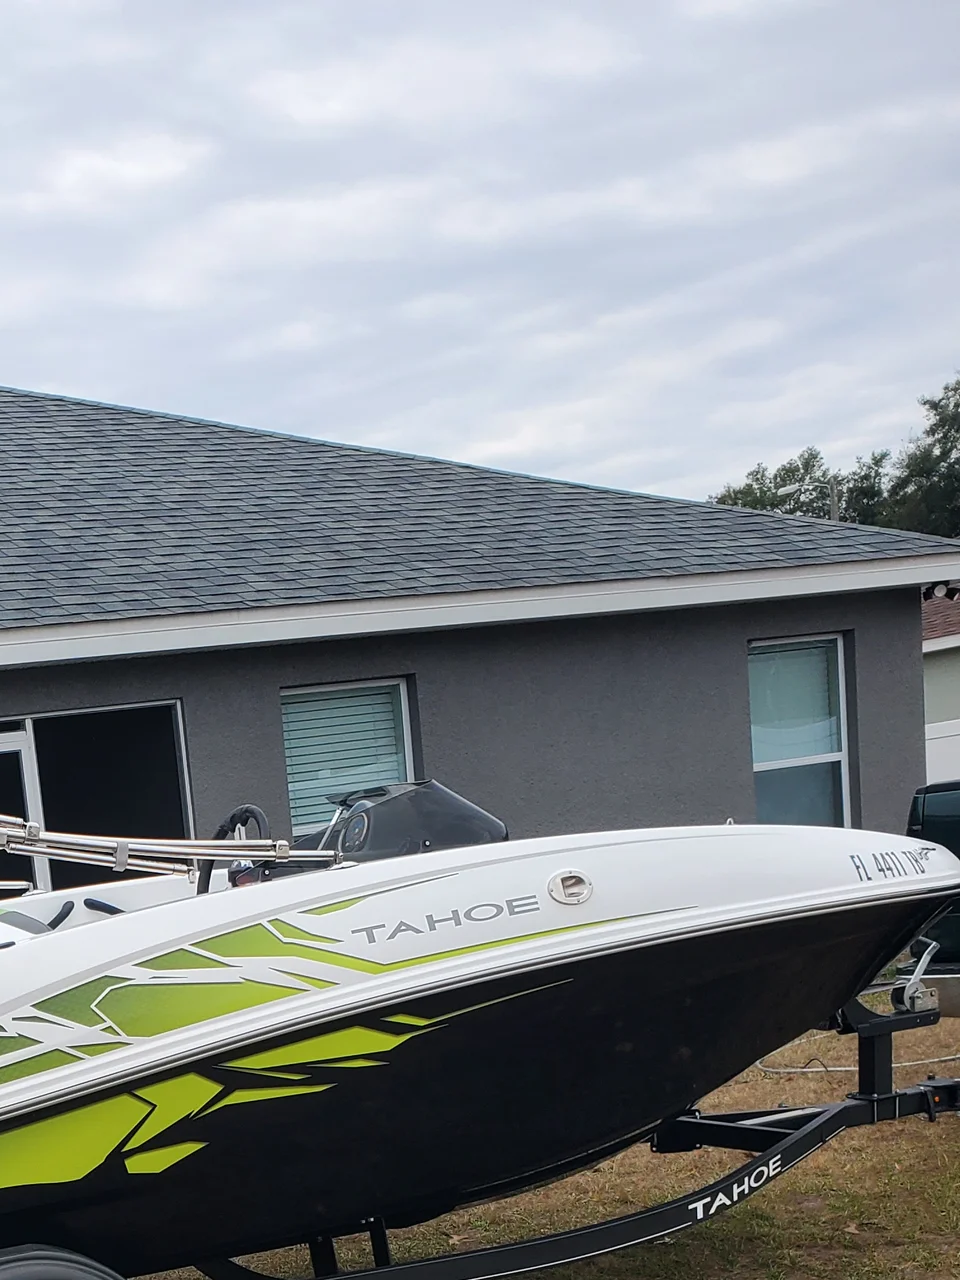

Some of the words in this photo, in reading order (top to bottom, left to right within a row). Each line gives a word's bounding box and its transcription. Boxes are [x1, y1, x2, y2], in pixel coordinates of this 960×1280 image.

[849, 854, 872, 881] FL
[350, 894, 540, 944] TAHOE
[687, 1153, 782, 1220] TAHOE
